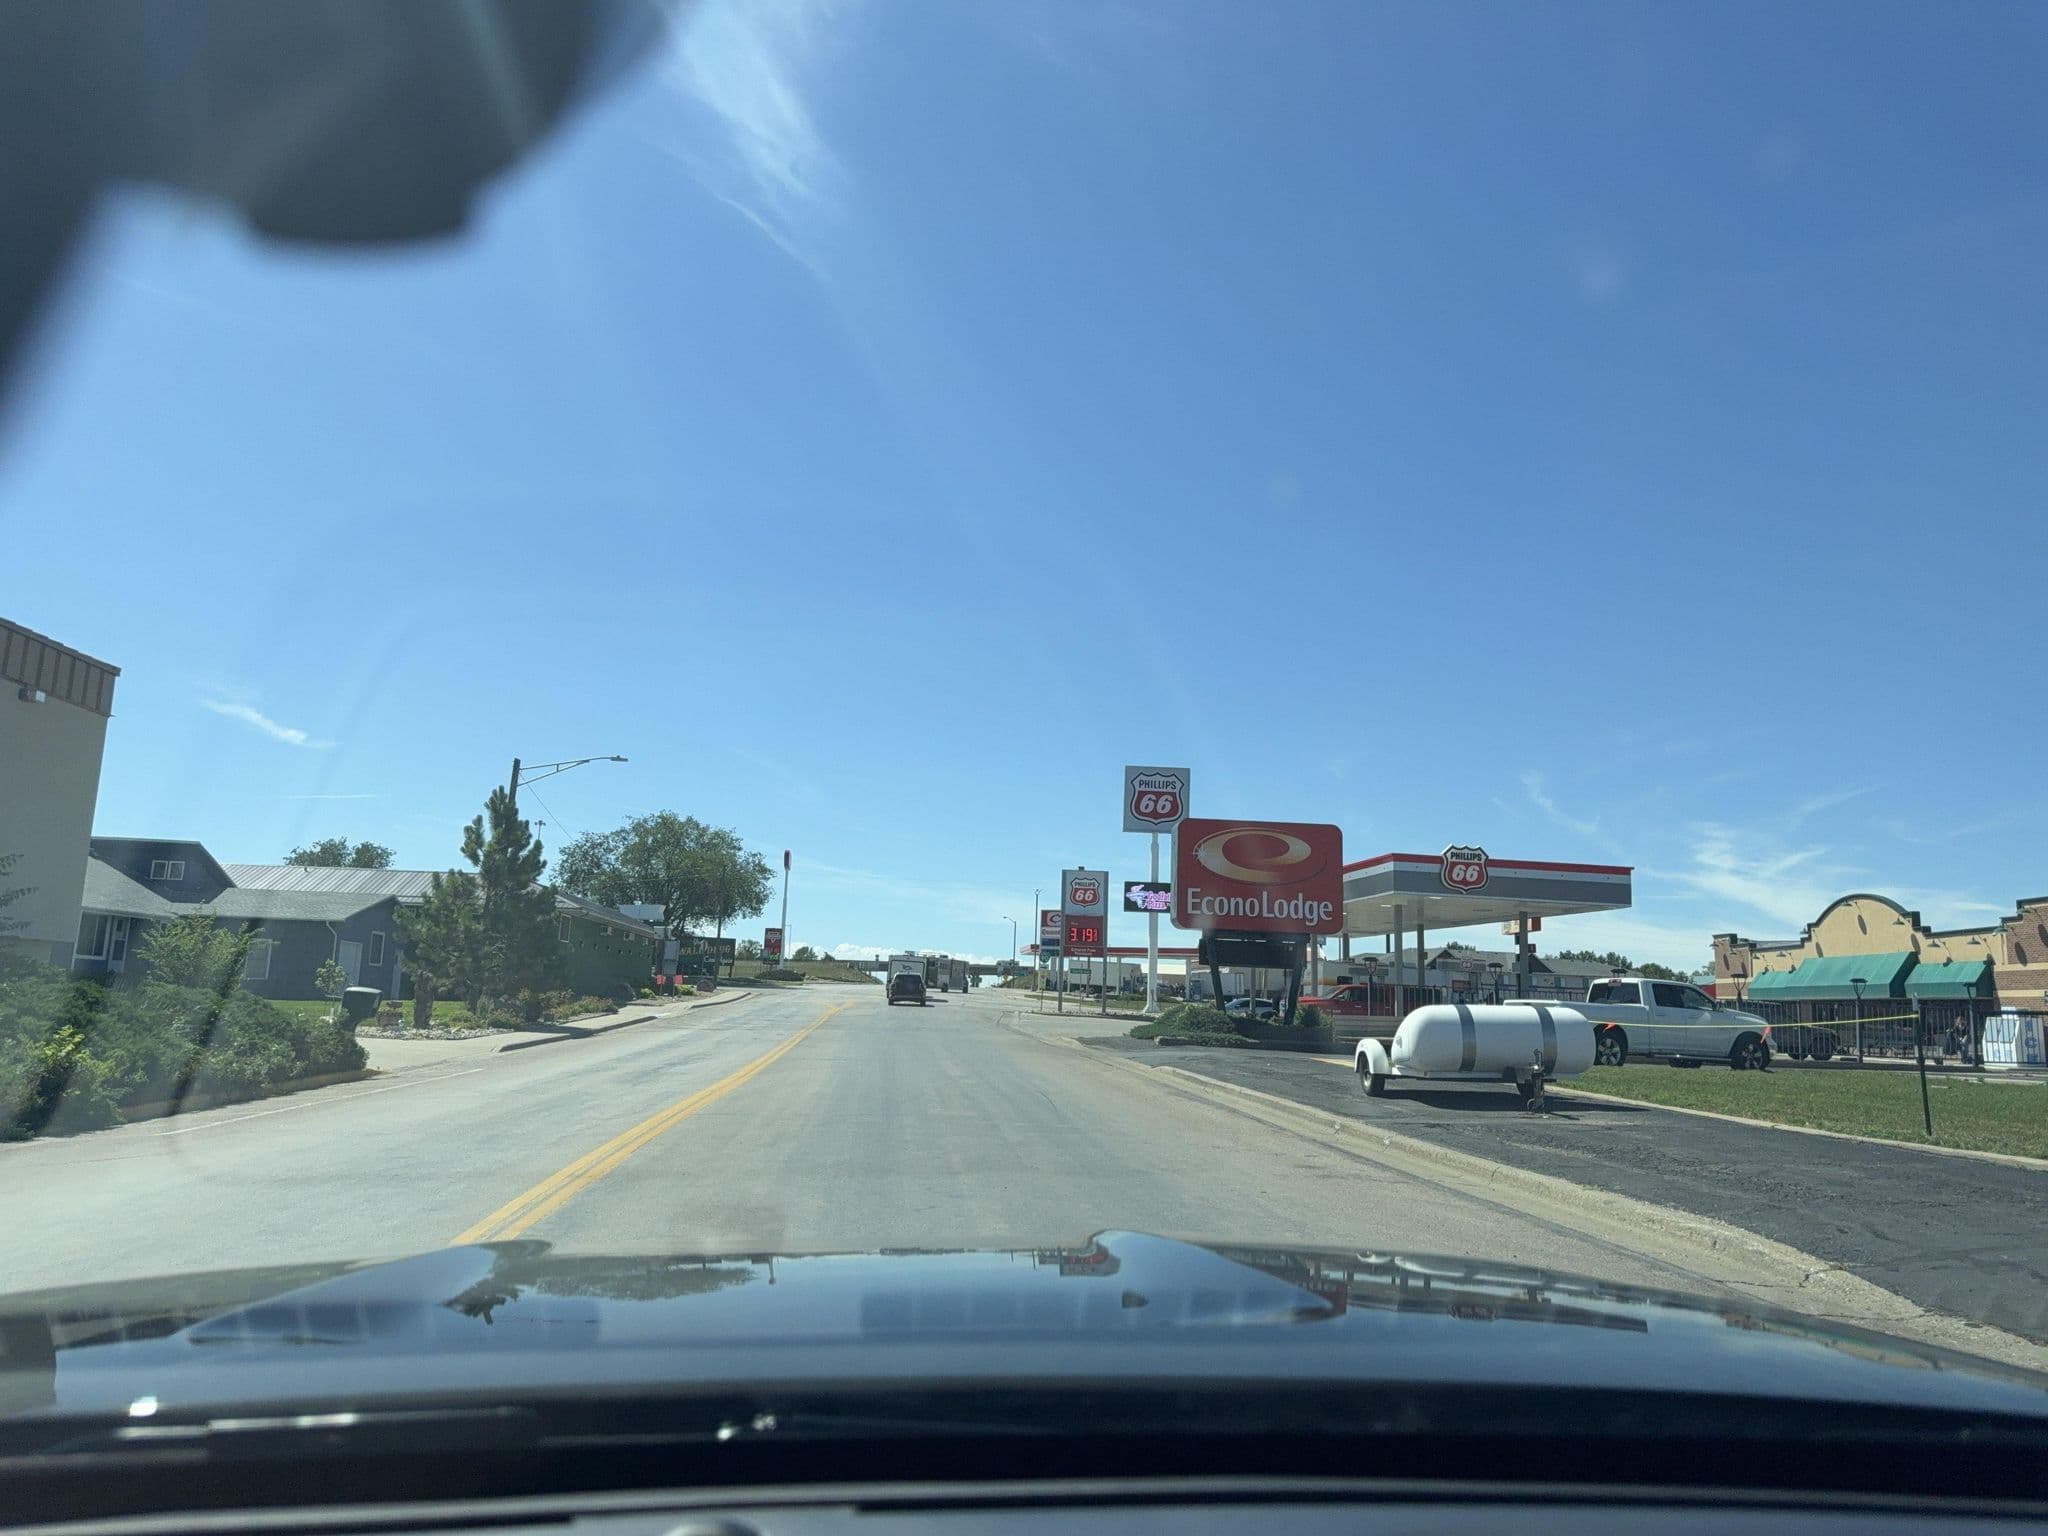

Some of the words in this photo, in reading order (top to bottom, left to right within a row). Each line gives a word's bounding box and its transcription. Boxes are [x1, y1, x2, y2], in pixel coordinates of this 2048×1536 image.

[1139, 779, 1177, 790] PHILLIPS
[1140, 794, 1173, 814] 66
[1450, 851, 1482, 861] PHILLIPS
[1452, 864, 1480, 882] 66
[1075, 889, 1094, 901] 66
